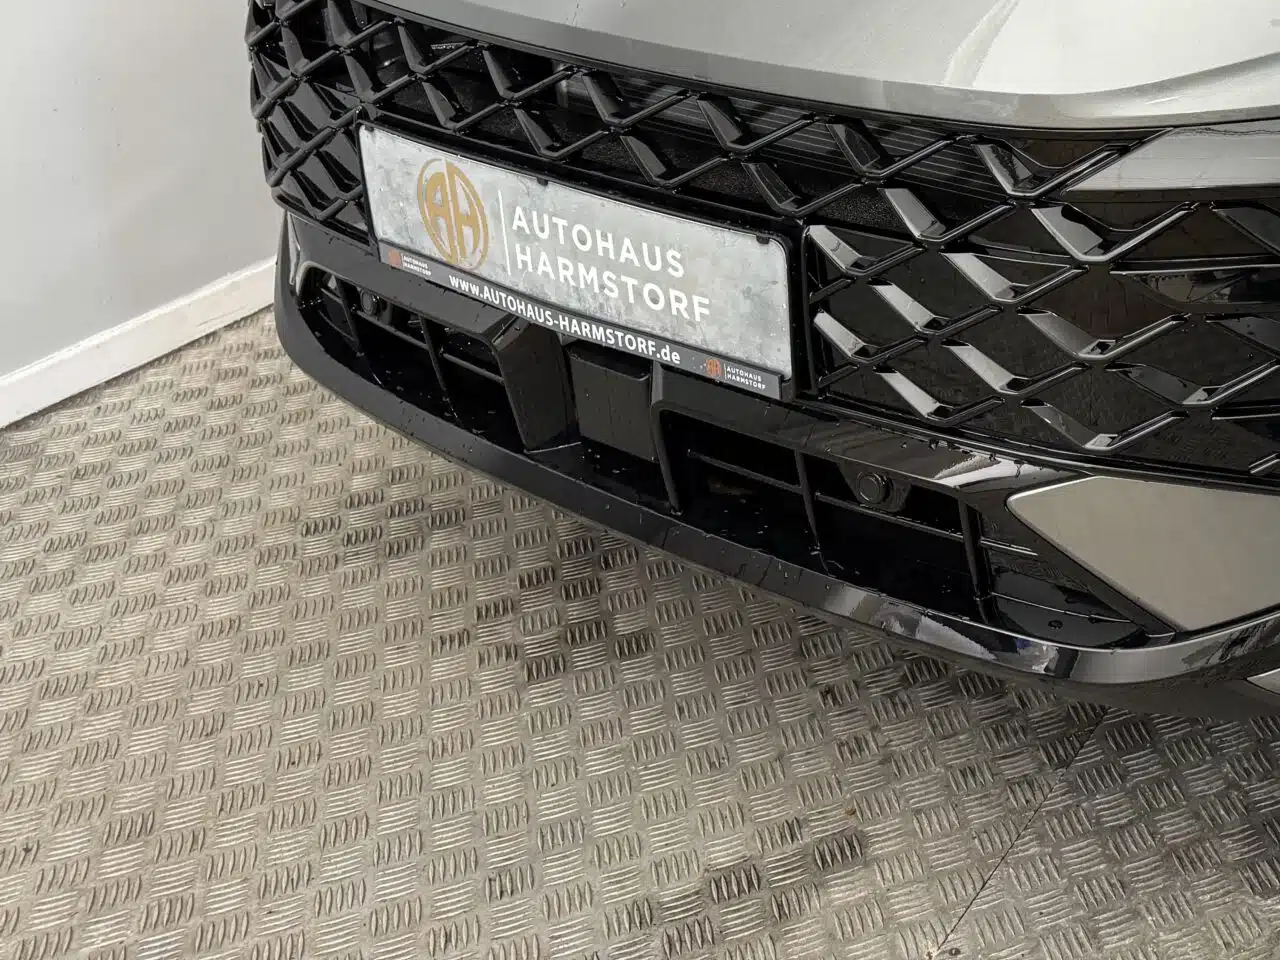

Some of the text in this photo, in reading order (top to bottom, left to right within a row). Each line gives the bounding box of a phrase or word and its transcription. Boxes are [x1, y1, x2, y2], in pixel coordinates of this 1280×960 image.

[511, 206, 685, 278] AUTOHAUS
[515, 243, 711, 322] HARMSTORF
[449, 274, 681, 365] www.AUTOHAUS-HARMSTORF.de
[726, 366, 762, 382] AUTOHAUS
[727, 373, 766, 389] HARMSTORF
